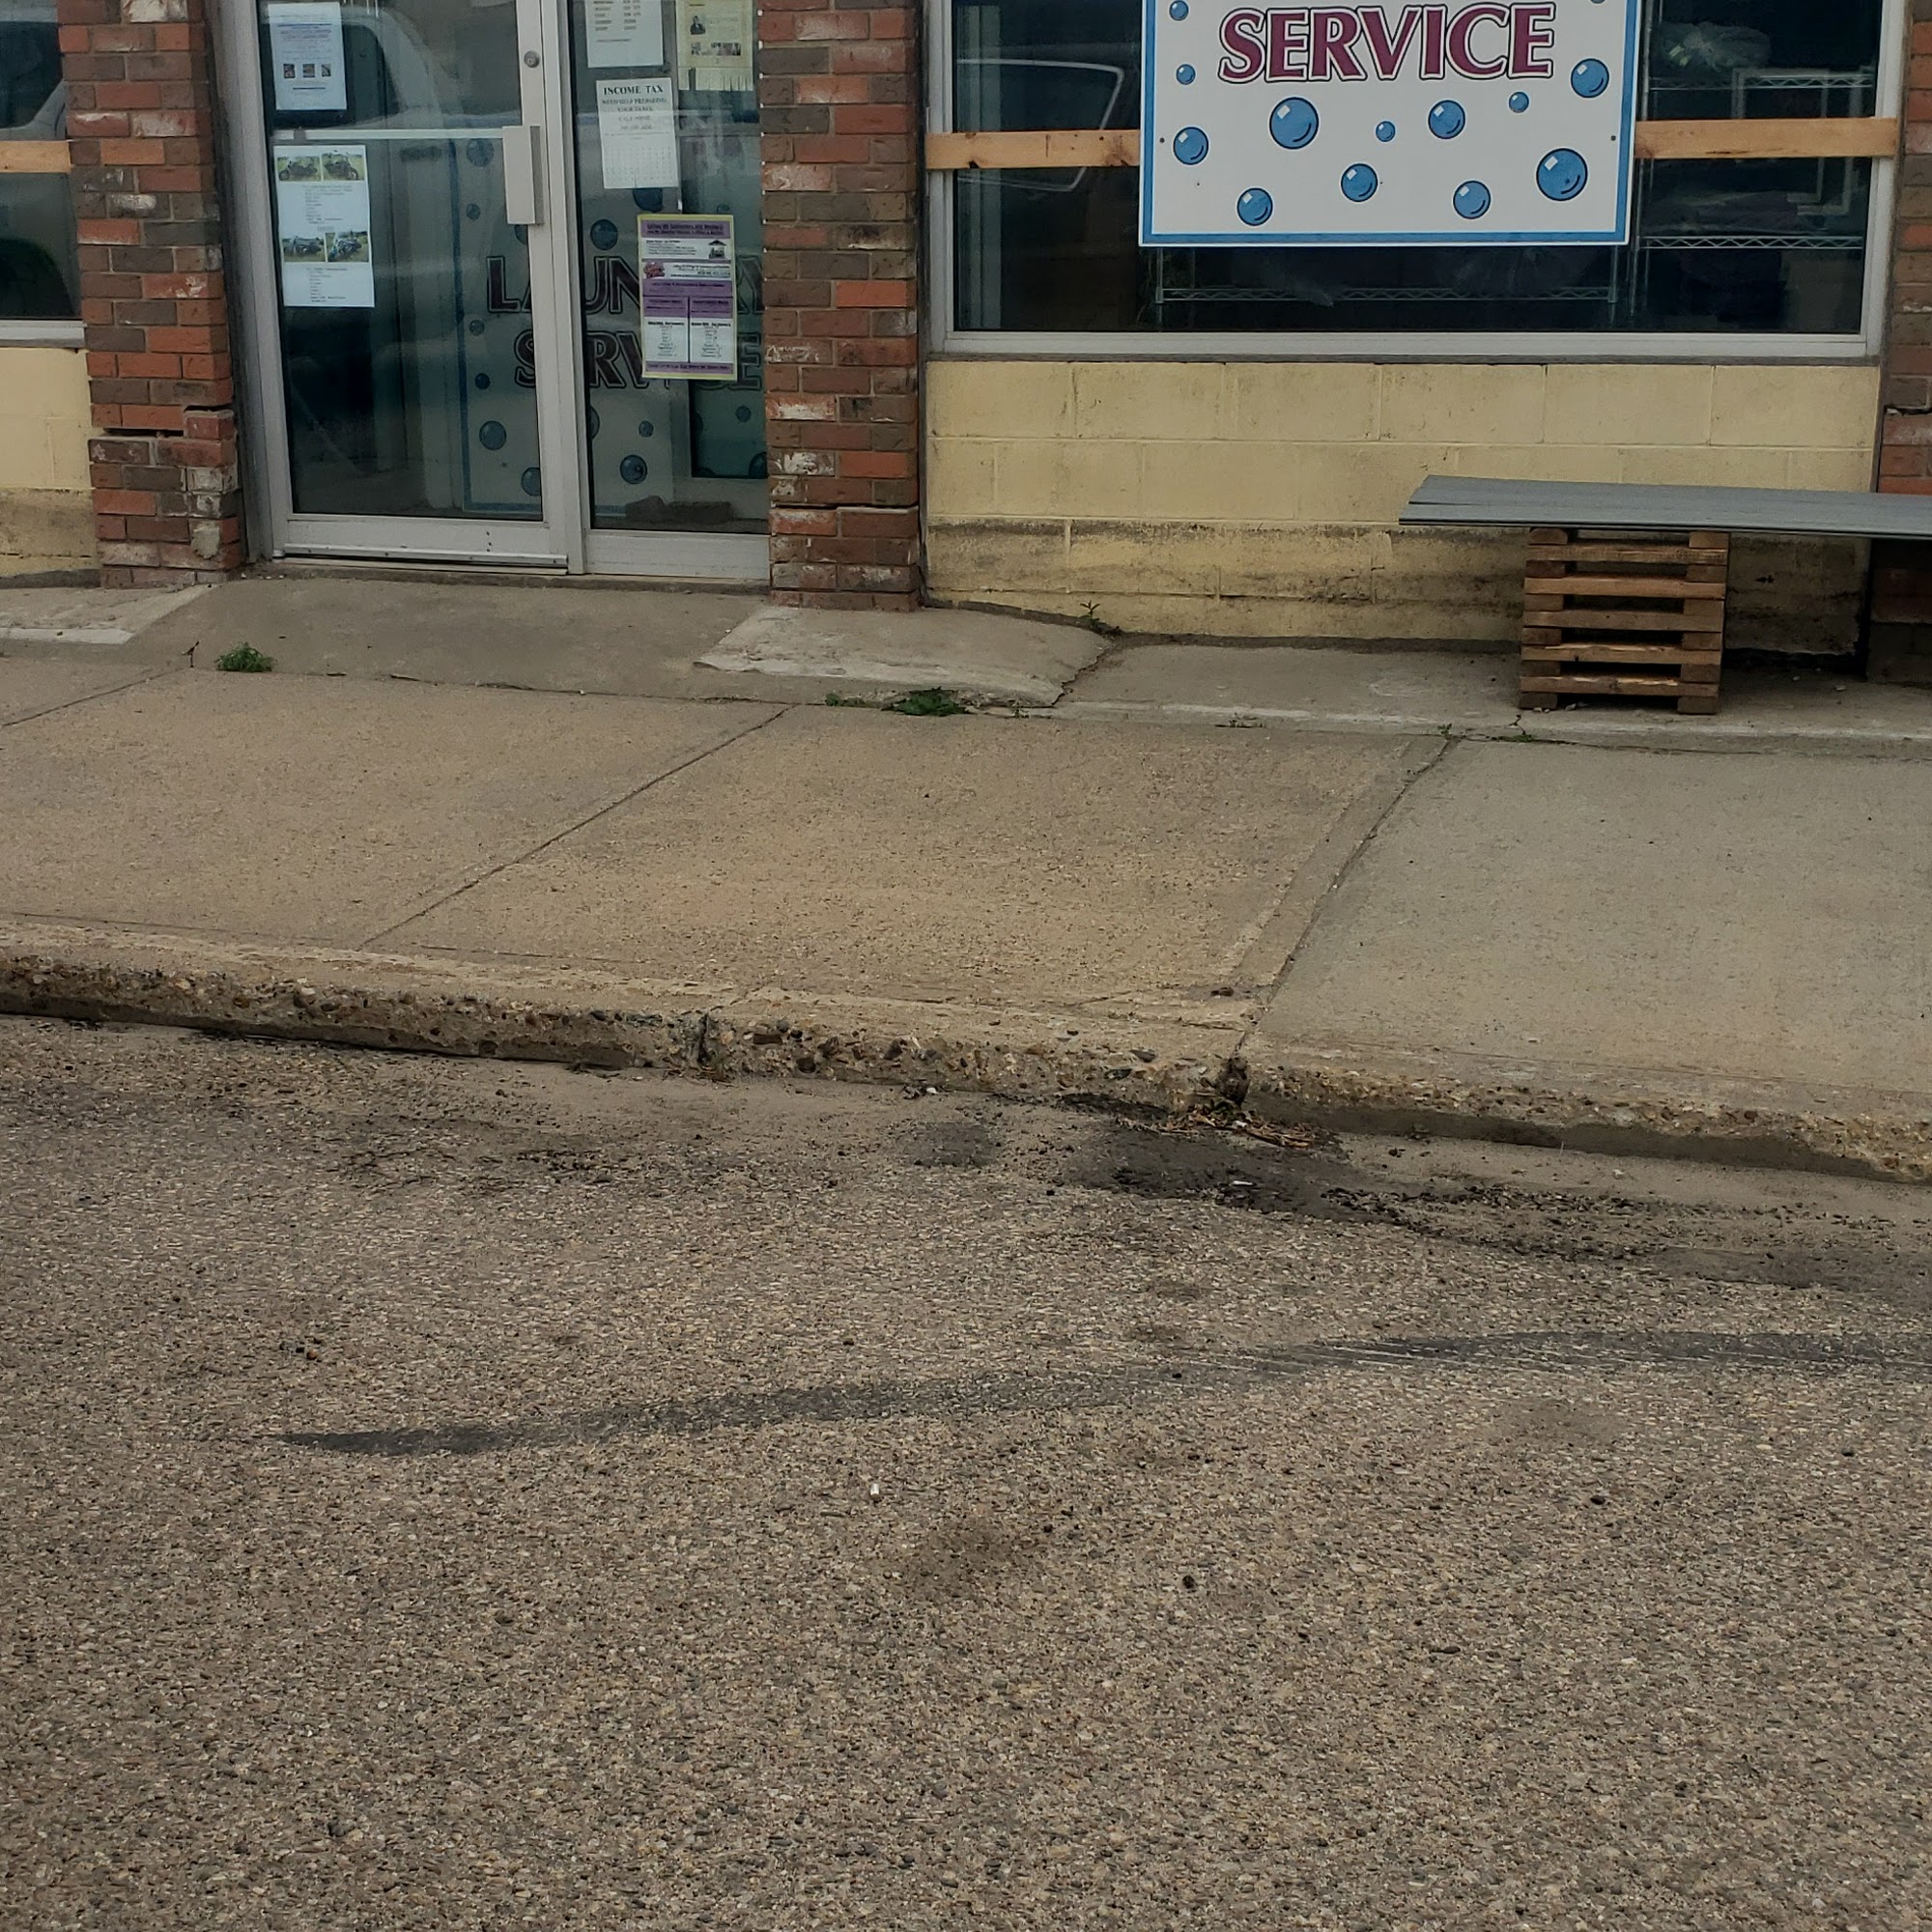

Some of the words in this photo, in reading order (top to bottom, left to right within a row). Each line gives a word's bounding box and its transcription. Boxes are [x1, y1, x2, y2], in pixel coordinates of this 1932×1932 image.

[1218, 2, 1556, 84] SERVICE
[603, 85, 641, 95] INCOME
[645, 84, 664, 94] TAX
